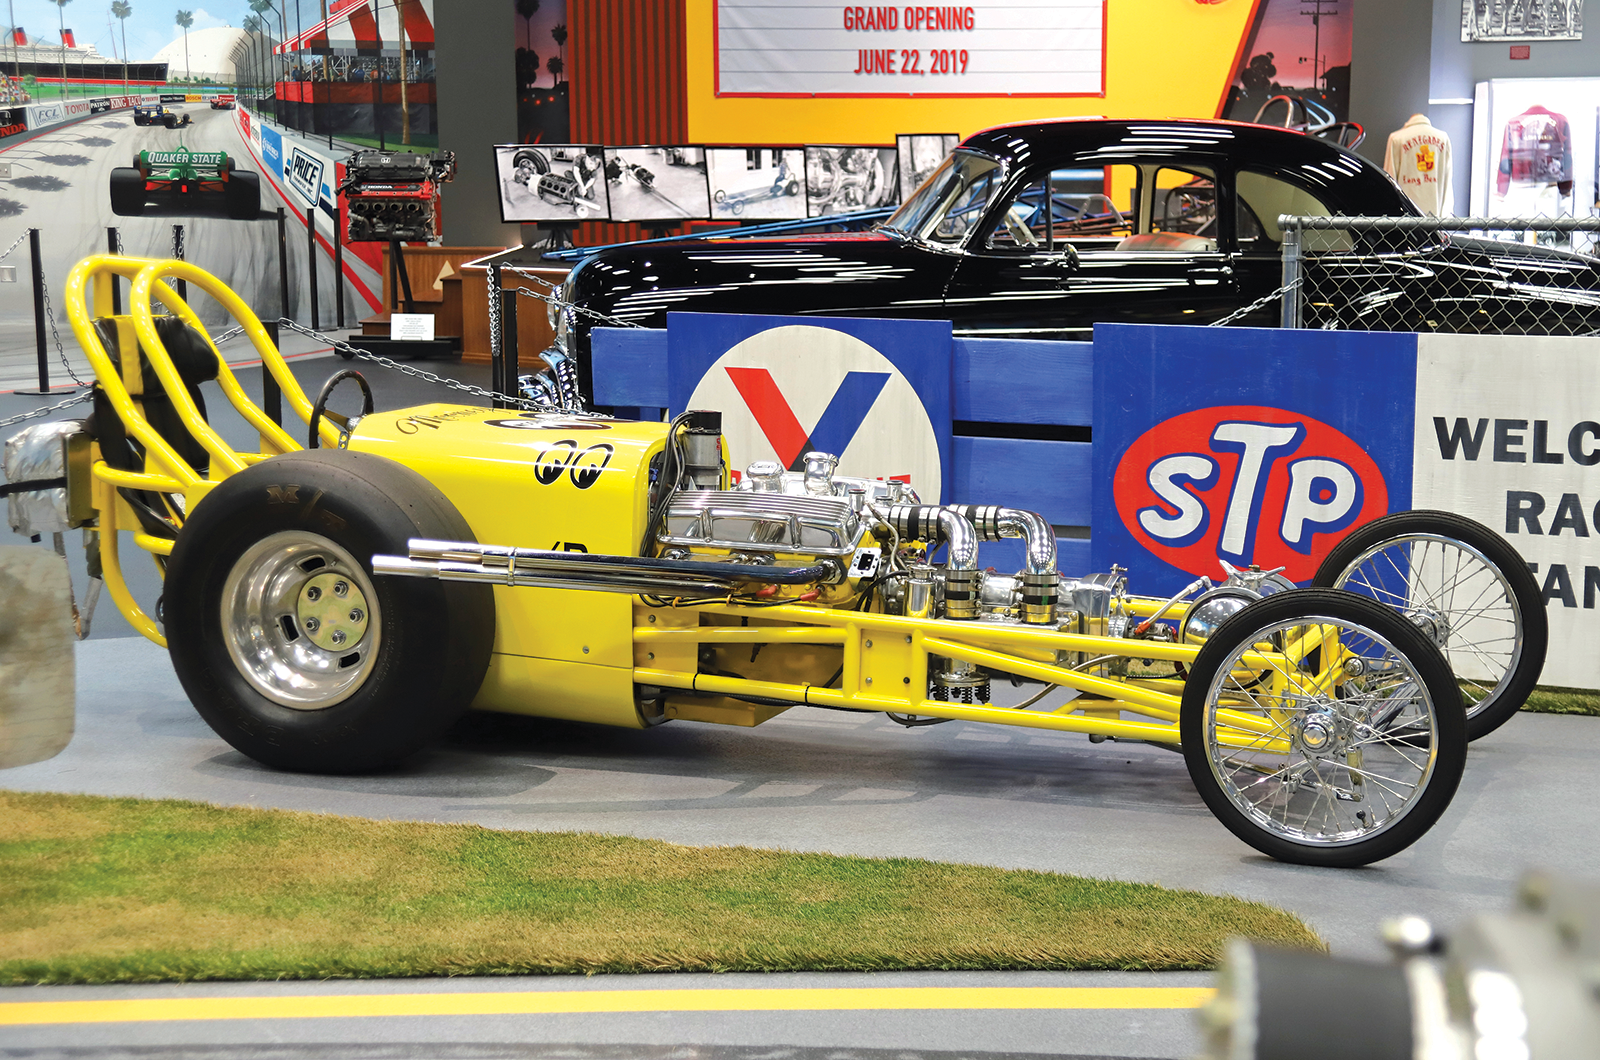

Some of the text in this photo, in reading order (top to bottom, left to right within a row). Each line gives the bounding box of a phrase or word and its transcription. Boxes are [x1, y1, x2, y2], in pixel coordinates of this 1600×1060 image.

[844, 7, 974, 31] GRAND OPENING
[853, 49, 968, 76] JUNE 22, 2019
[39, 108, 59, 119] FCL
[65, 103, 90, 115] TOYOTA
[111, 98, 127, 109] KING
[127, 96, 142, 106] TACO
[147, 152, 222, 164] QUAKER STATE
[293, 155, 319, 187] PRICE
[1139, 422, 1357, 557] STP
[1505, 490, 1600, 537] RA
